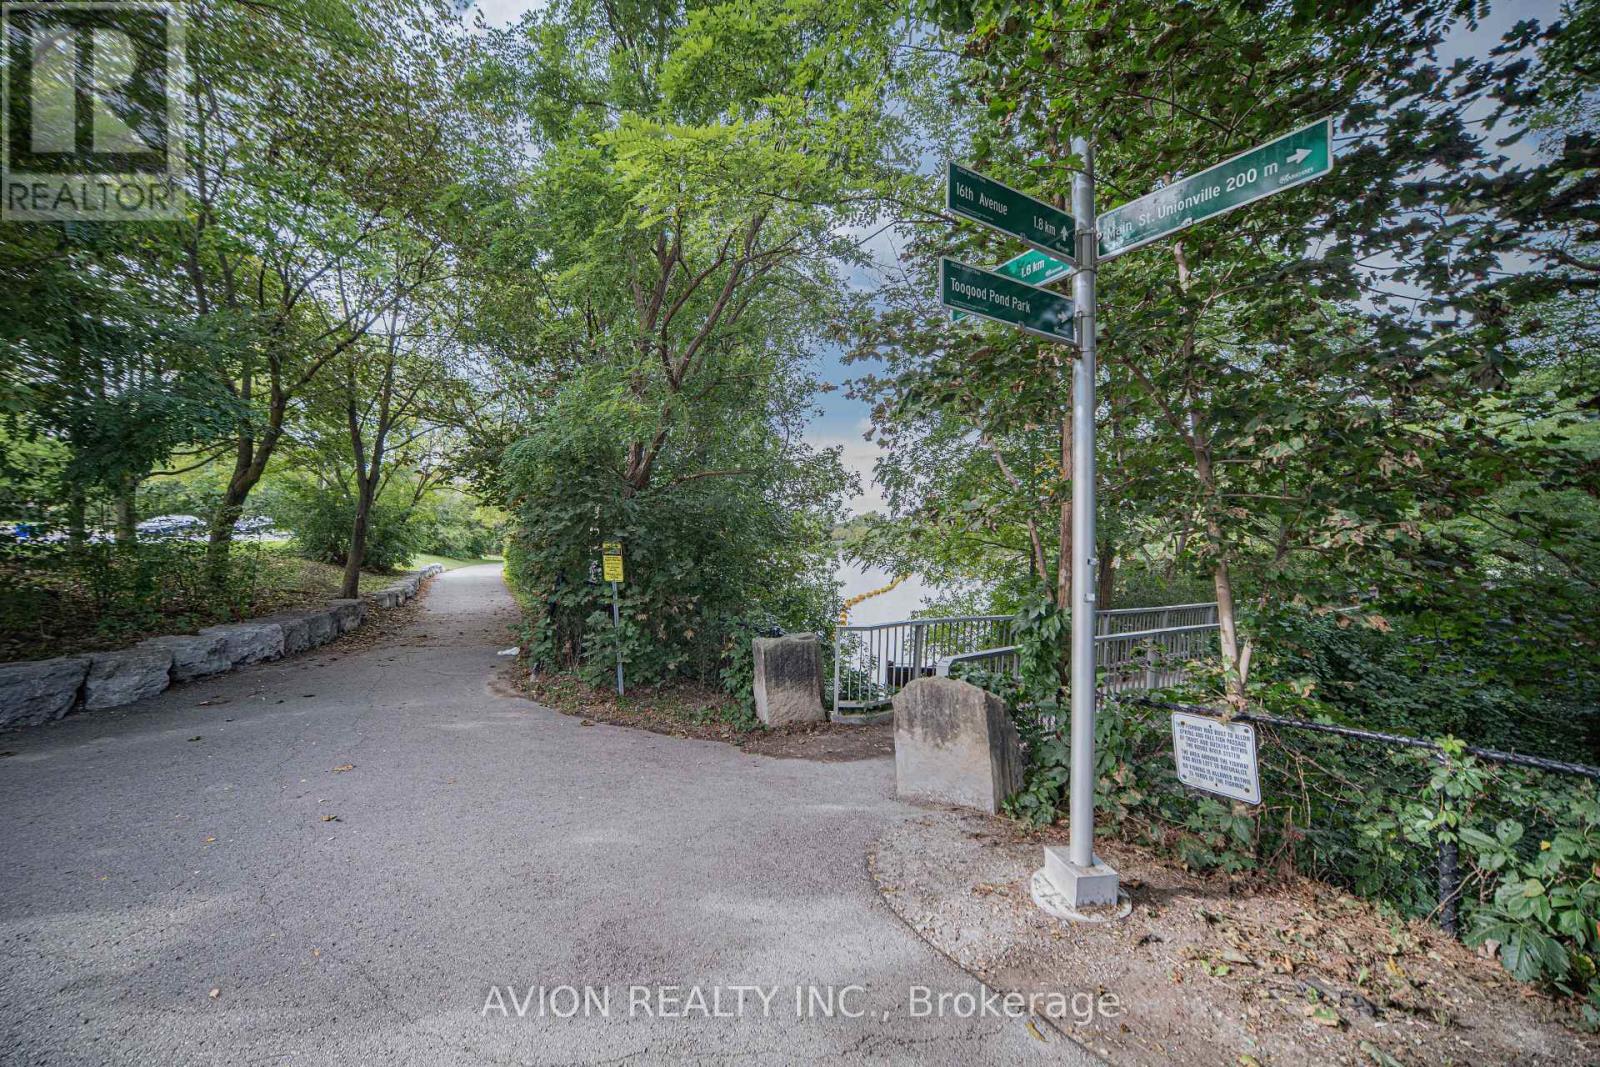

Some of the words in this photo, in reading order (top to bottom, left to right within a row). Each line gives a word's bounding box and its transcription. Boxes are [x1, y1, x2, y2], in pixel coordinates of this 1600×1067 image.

[956, 182, 974, 201] 16th
[979, 192, 1008, 216] Avenue
[1139, 213, 1155, 226] St.
[1157, 185, 1221, 218] Unionville
[1226, 168, 1257, 192] 200
[1264, 162, 1278, 177] m
[1033, 215, 1044, 231] 1.8
[1044, 221, 1056, 236] km
[1032, 259, 1045, 272] km
[950, 277, 987, 300] Toogood
[989, 289, 1010, 307] Pond
[1012, 296, 1031, 313] Park
